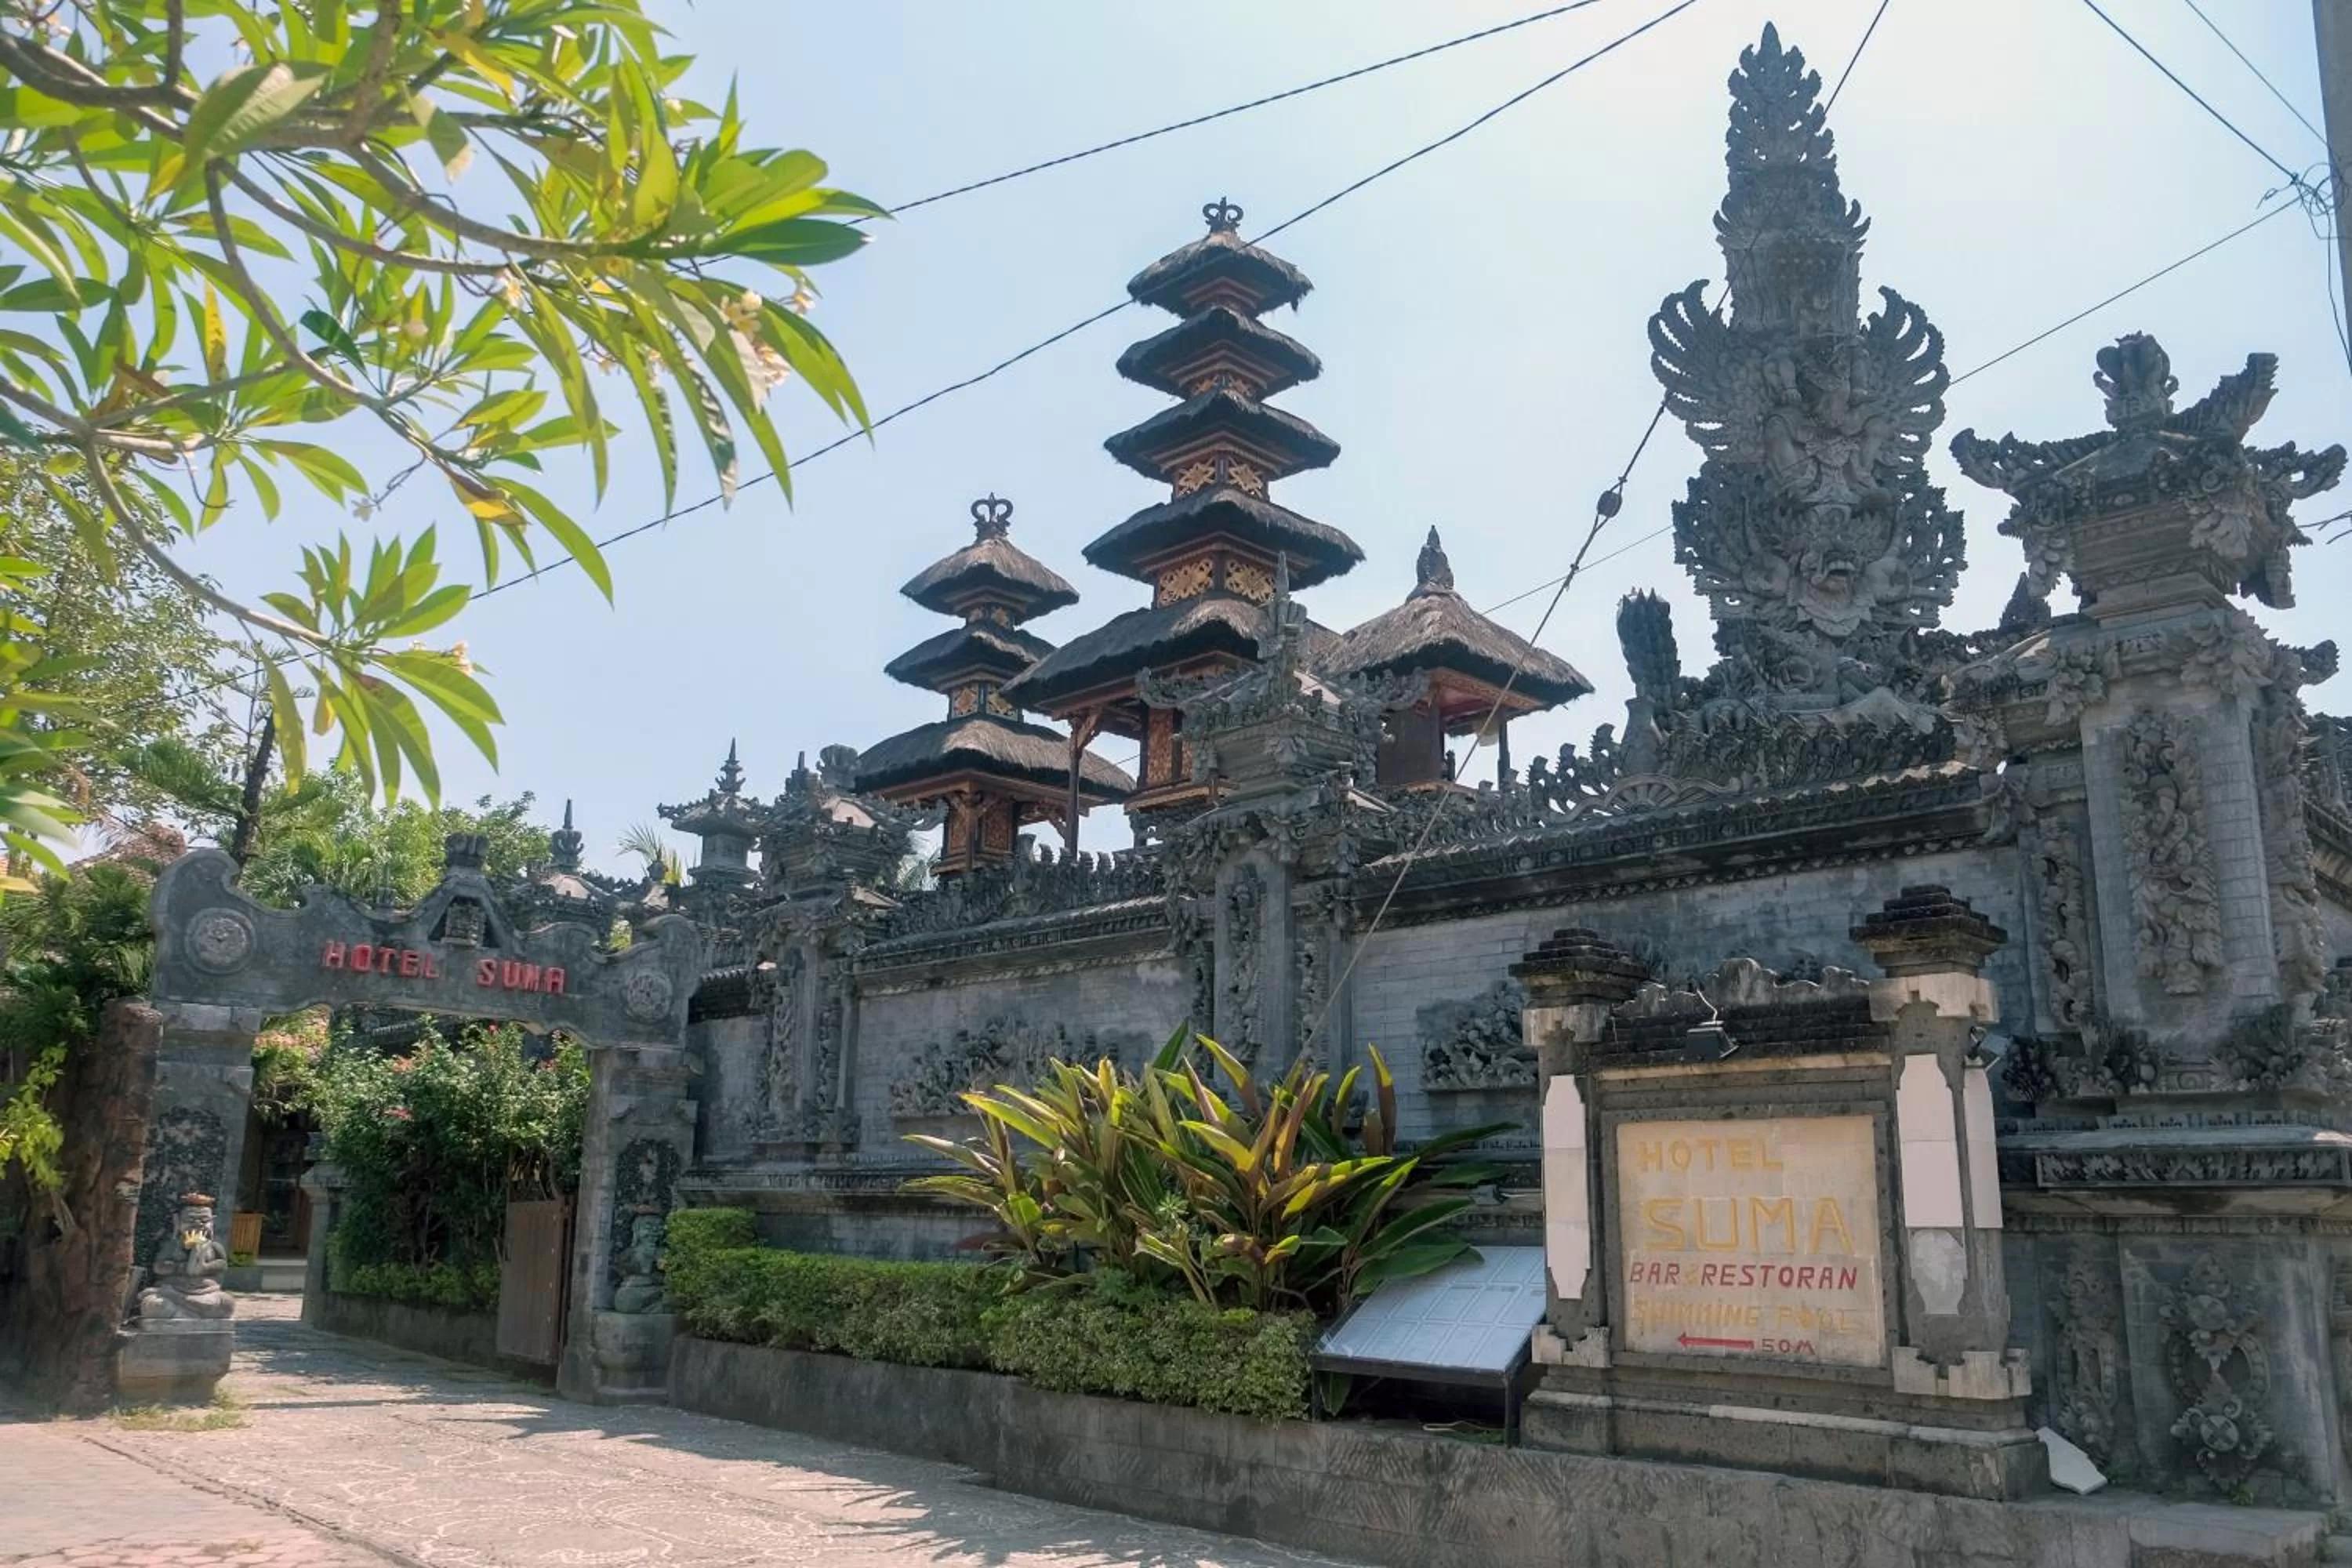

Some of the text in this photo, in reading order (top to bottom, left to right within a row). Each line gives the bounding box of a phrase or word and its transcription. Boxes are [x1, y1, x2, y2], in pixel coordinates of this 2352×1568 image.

[322, 938, 565, 994] HOTEL SUMA
[1638, 1139, 1783, 1171] HOTEL
[1643, 1196, 1853, 1254] SUMA
[1631, 1261, 1680, 1284] BAR
[1700, 1263, 1858, 1290] RESTORAN
